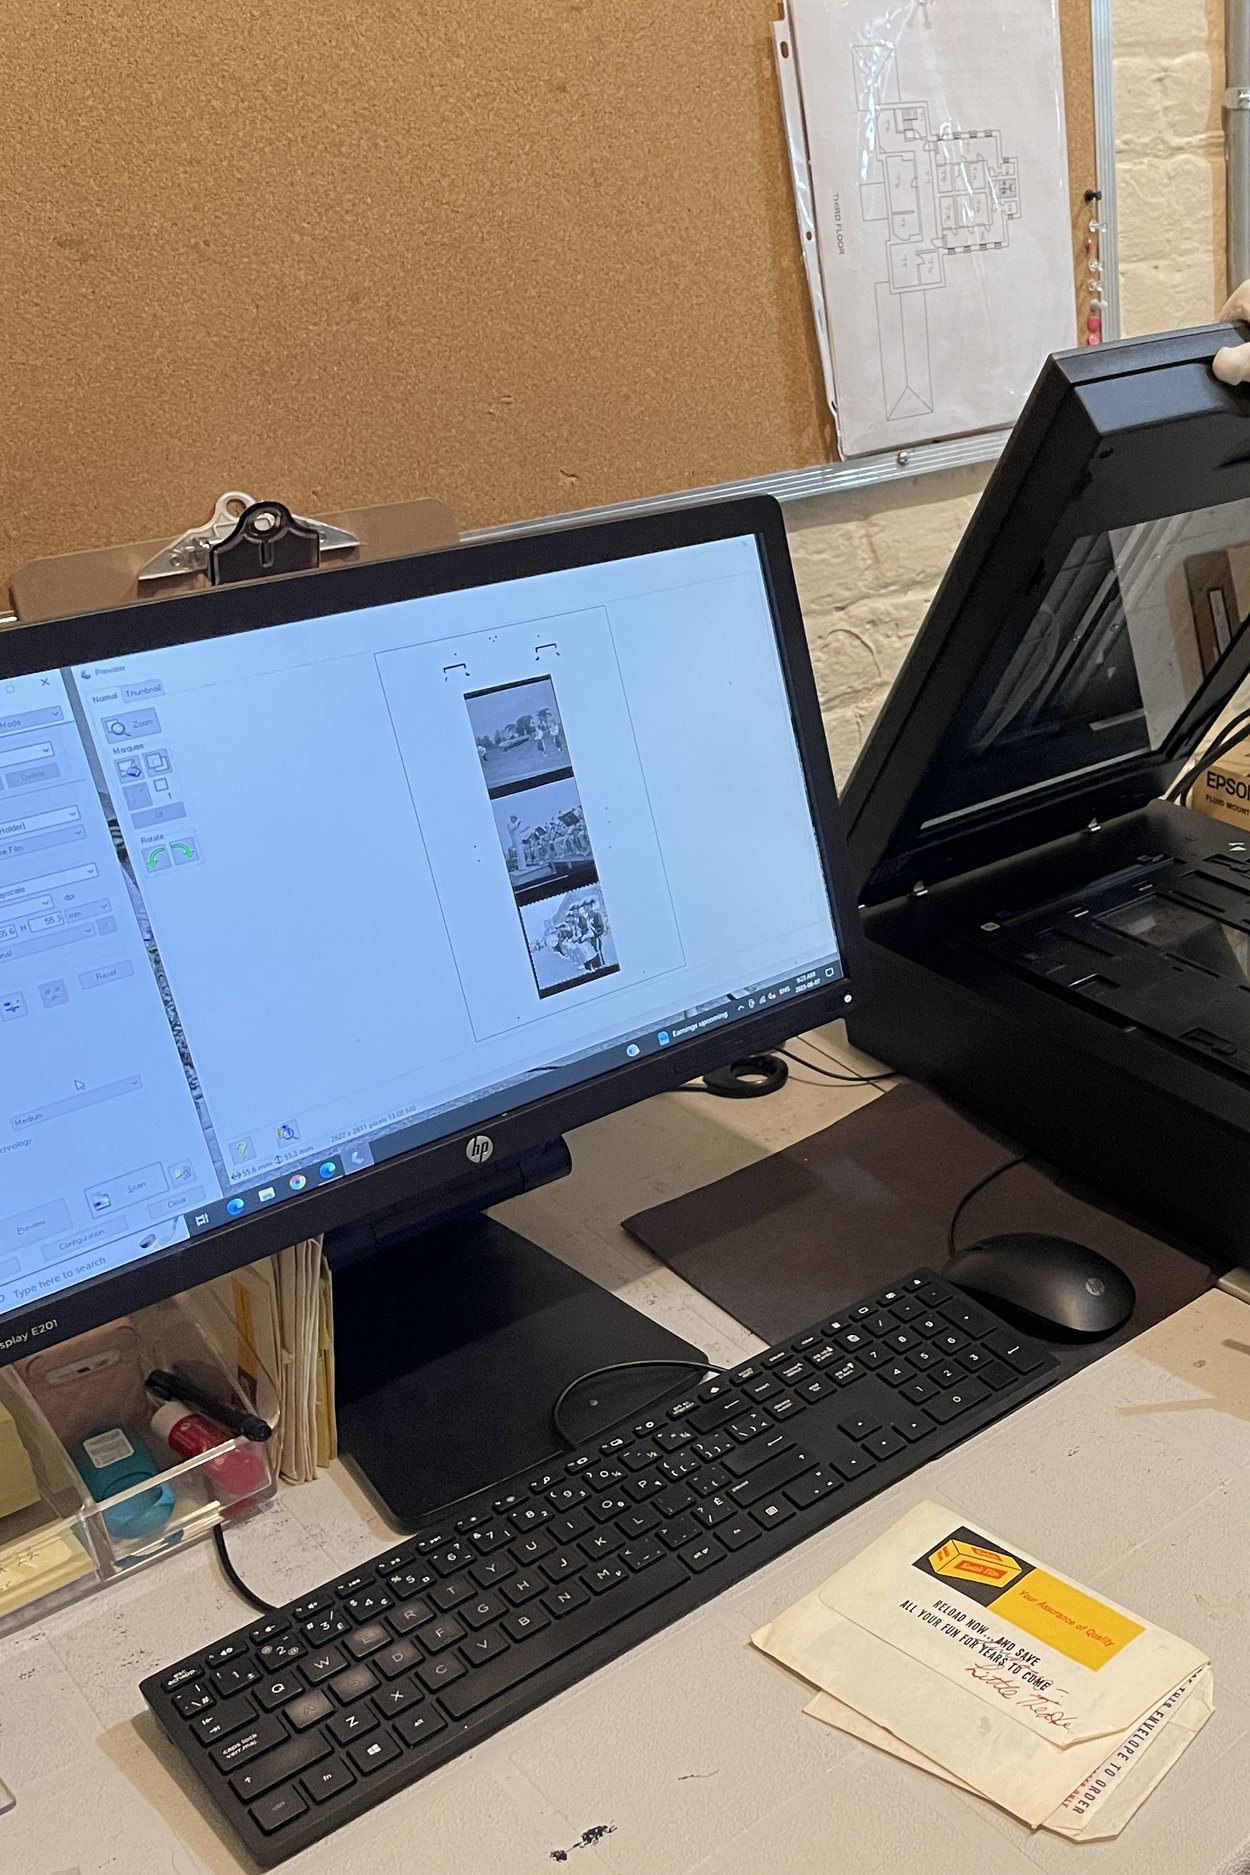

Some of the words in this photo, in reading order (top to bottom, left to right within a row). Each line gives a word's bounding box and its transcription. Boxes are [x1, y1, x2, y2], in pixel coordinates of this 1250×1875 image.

[833, 192, 841, 221] THIRD
[836, 223, 845, 255] FLOOR
[92, 692, 118, 703] Normal
[125, 684, 162, 698] Thumbnail
[132, 719, 154, 729] Zoom
[113, 742, 144, 755] Marquee
[1205, 794, 1225, 808] FLUID
[1226, 801, 1250, 816] MOUNT
[141, 834, 164, 844] Rotate
[96, 969, 118, 980] Reset
[698, 1010, 729, 1028] upcoming
[14, 1113, 44, 1127] Medium
[466, 1136, 493, 1163] hp
[127, 1181, 146, 1194] Scan
[59, 1229, 105, 1250] Configuration
[14, 1281, 37, 1299] Type
[39, 1274, 61, 1291] here
[63, 1269, 73, 1281] to
[75, 1257, 106, 1274] search
[31, 1319, 58, 1336] E201
[1019, 1589, 1039, 1603] Your
[1037, 1601, 1076, 1626] Assurance
[1075, 1624, 1088, 1632] of
[1085, 1628, 1115, 1647] Quality
[933, 1600, 966, 1623] RELOAD
[1015, 1648, 1041, 1667] SAVE
[899, 1599, 916, 1614] ALL
[917, 1609, 942, 1628] YOUR
[940, 1623, 960, 1639] FUN
[959, 1634, 979, 1650] FOR
[978, 1643, 1008, 1666] YEARS
[1009, 1662, 1021, 1676] TO
[1022, 1671, 1052, 1692] COME
[965, 1662, 1020, 1700] Little
[222, 1742, 241, 1755] caps
[241, 1733, 258, 1745] lock
[1117, 1709, 1165, 1761] ENVELOPE
[322, 1773, 332, 1781] fn
[1104, 1762, 1122, 1778] TO
[1072, 1779, 1107, 1815] ORDER
